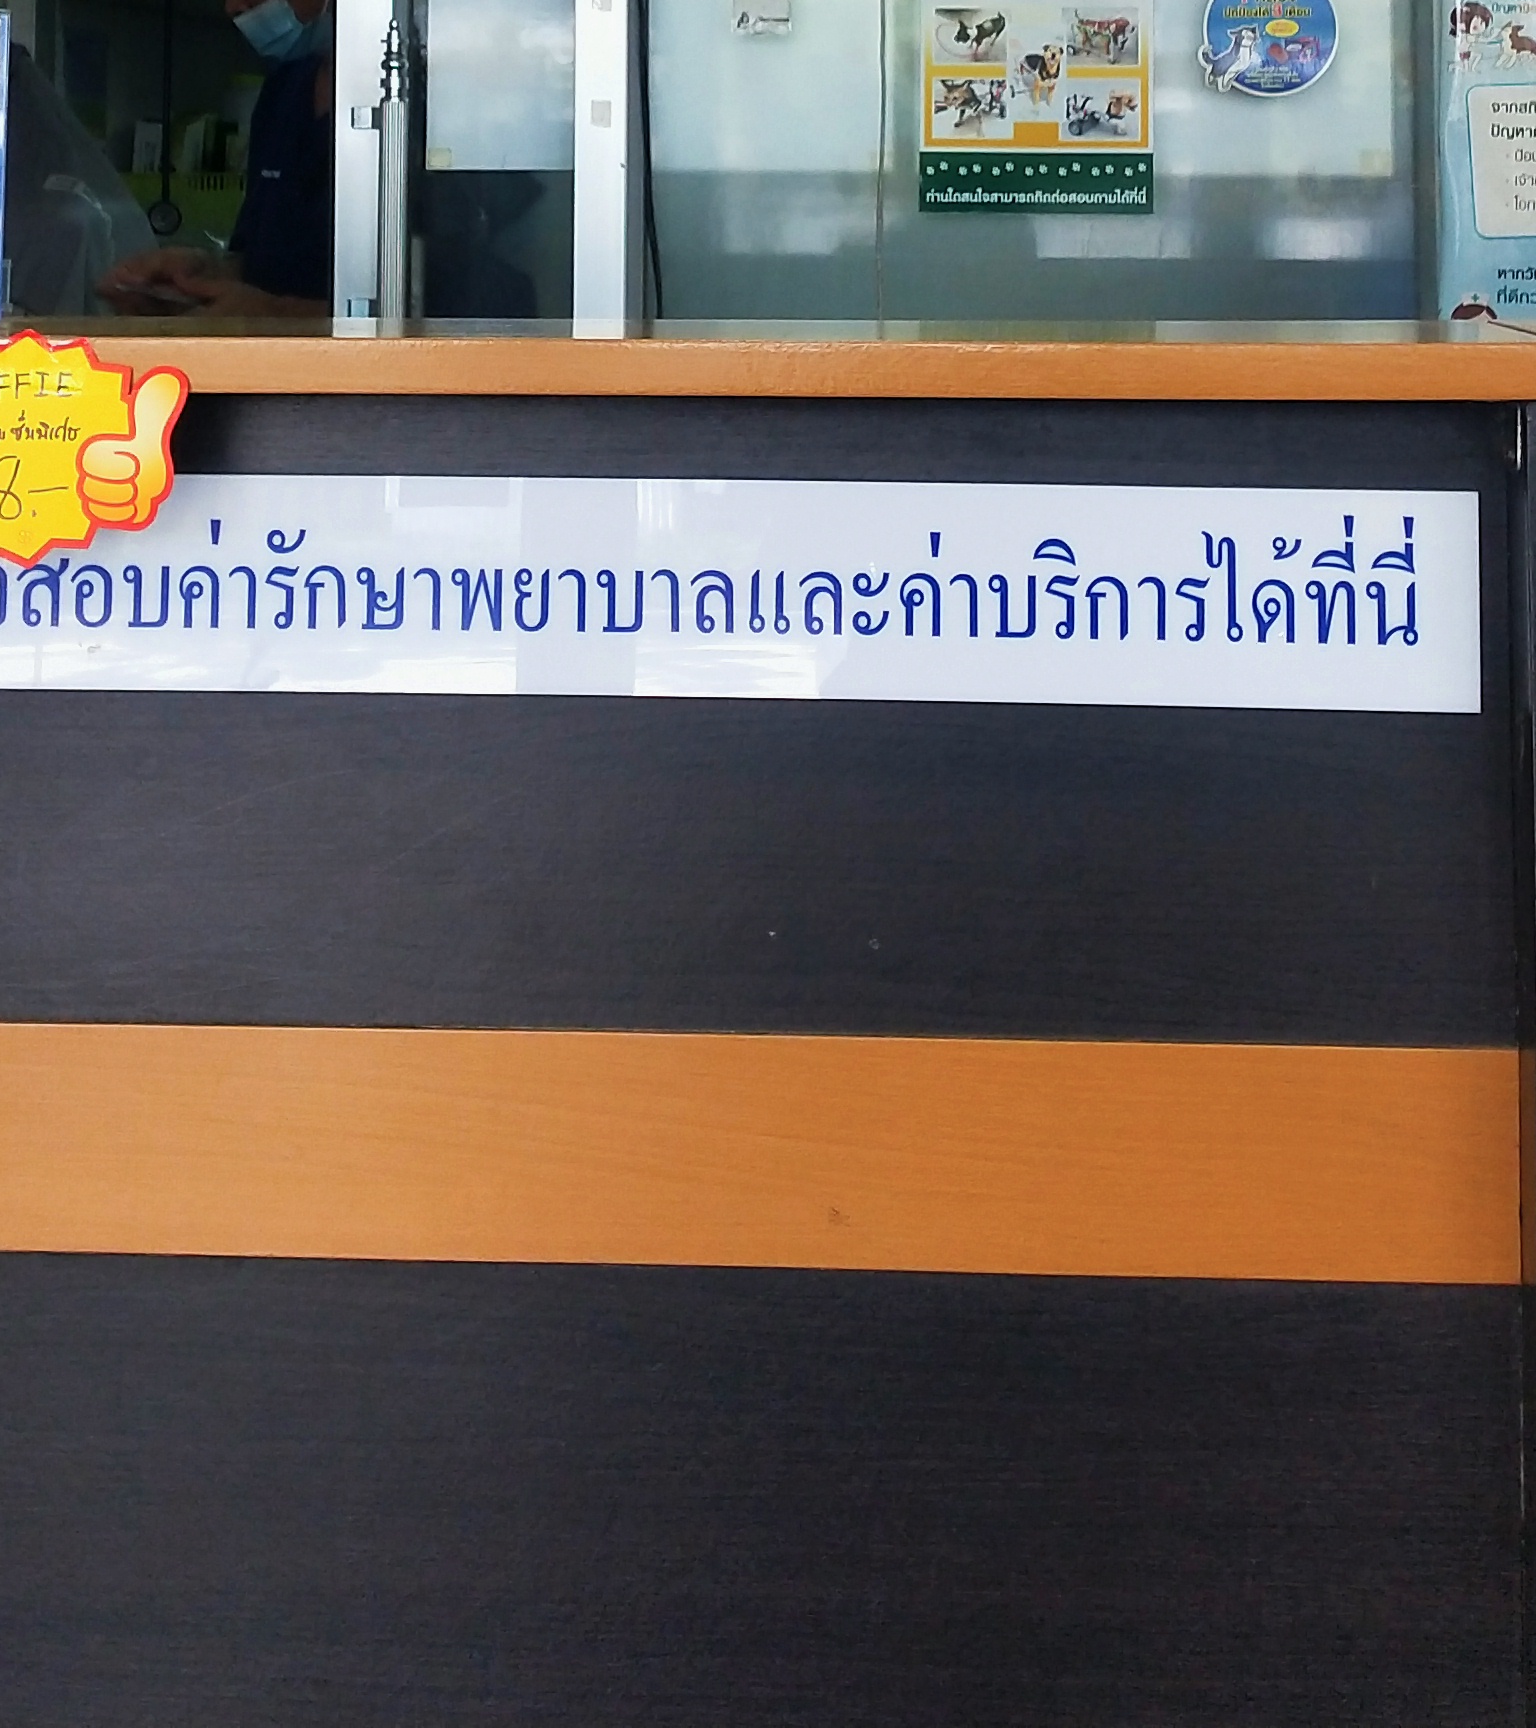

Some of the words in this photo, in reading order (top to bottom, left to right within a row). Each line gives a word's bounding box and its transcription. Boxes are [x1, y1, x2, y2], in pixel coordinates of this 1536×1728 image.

[925, 186, 1148, 205] ท่านใดสนใจสามารถติดต่อสอบถามได้ที่นี่
